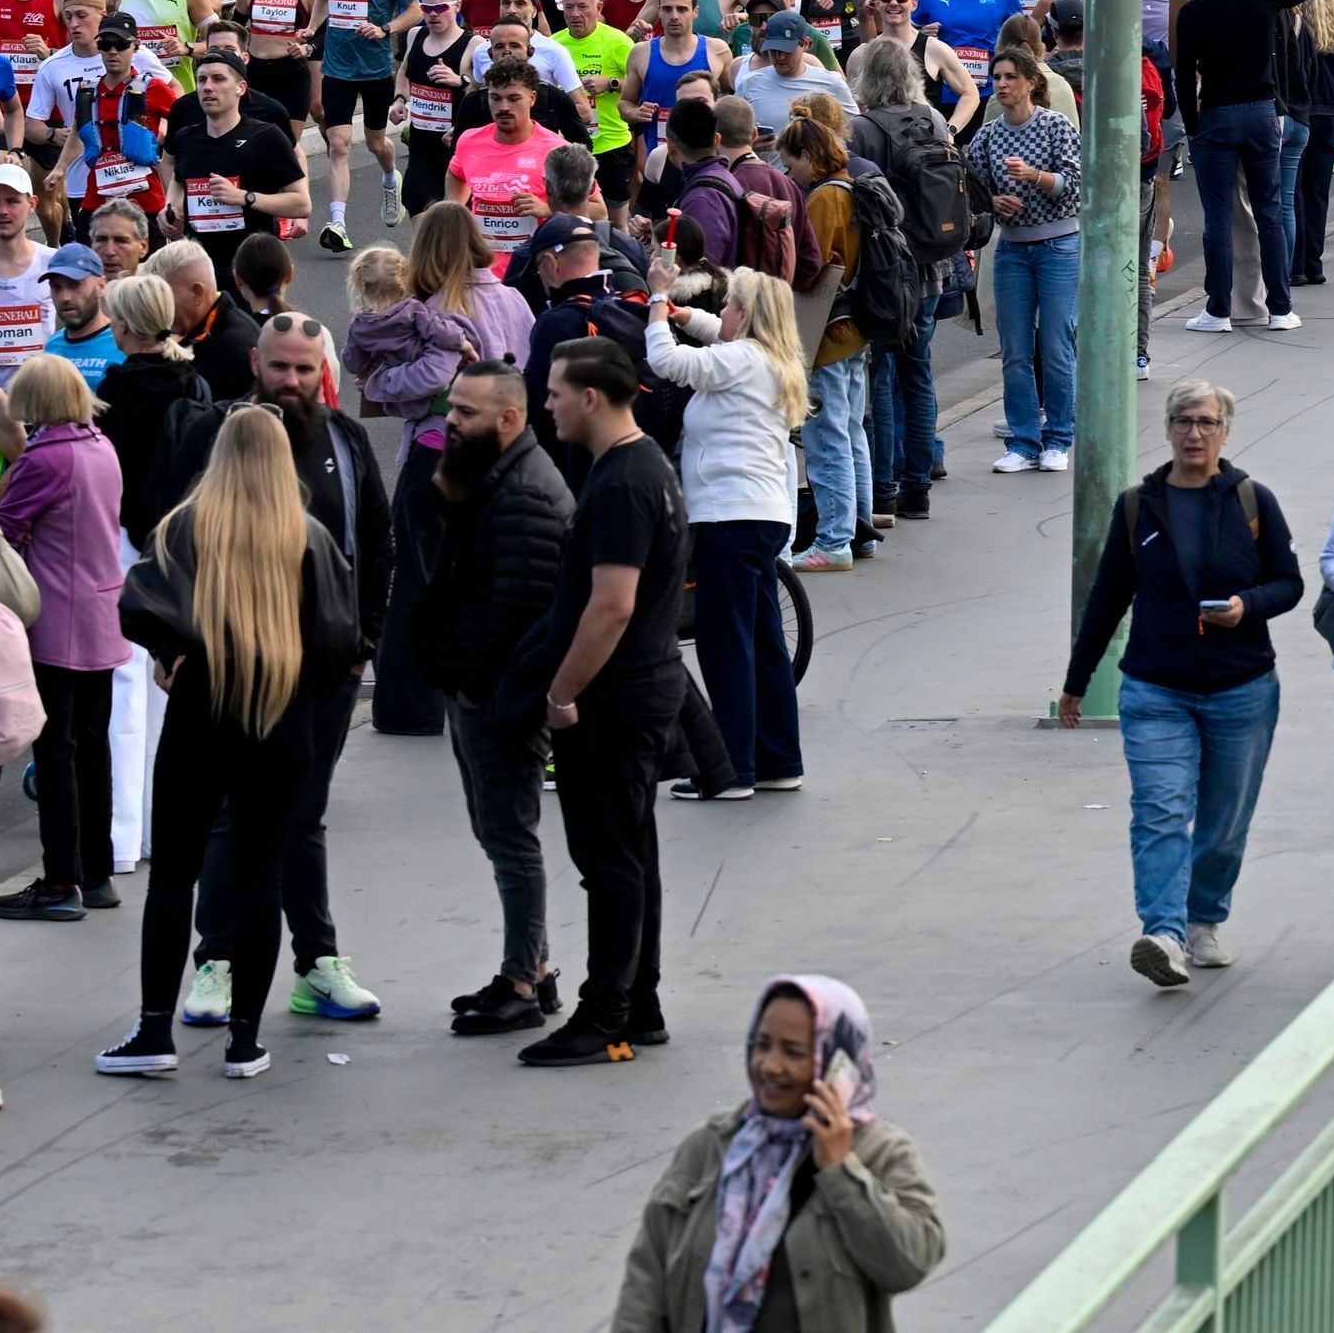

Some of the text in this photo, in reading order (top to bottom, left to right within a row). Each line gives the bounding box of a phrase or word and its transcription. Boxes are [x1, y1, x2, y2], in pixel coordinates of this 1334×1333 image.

[261, 6, 287, 17] Taylor
[337, 2, 357, 11] Knut
[9, 54, 37, 64] Klaus
[416, 88, 451, 100] GENERALI
[412, 98, 447, 112] Hendrik
[104, 165, 136, 177] Niklas
[484, 217, 519, 229] Enrico
